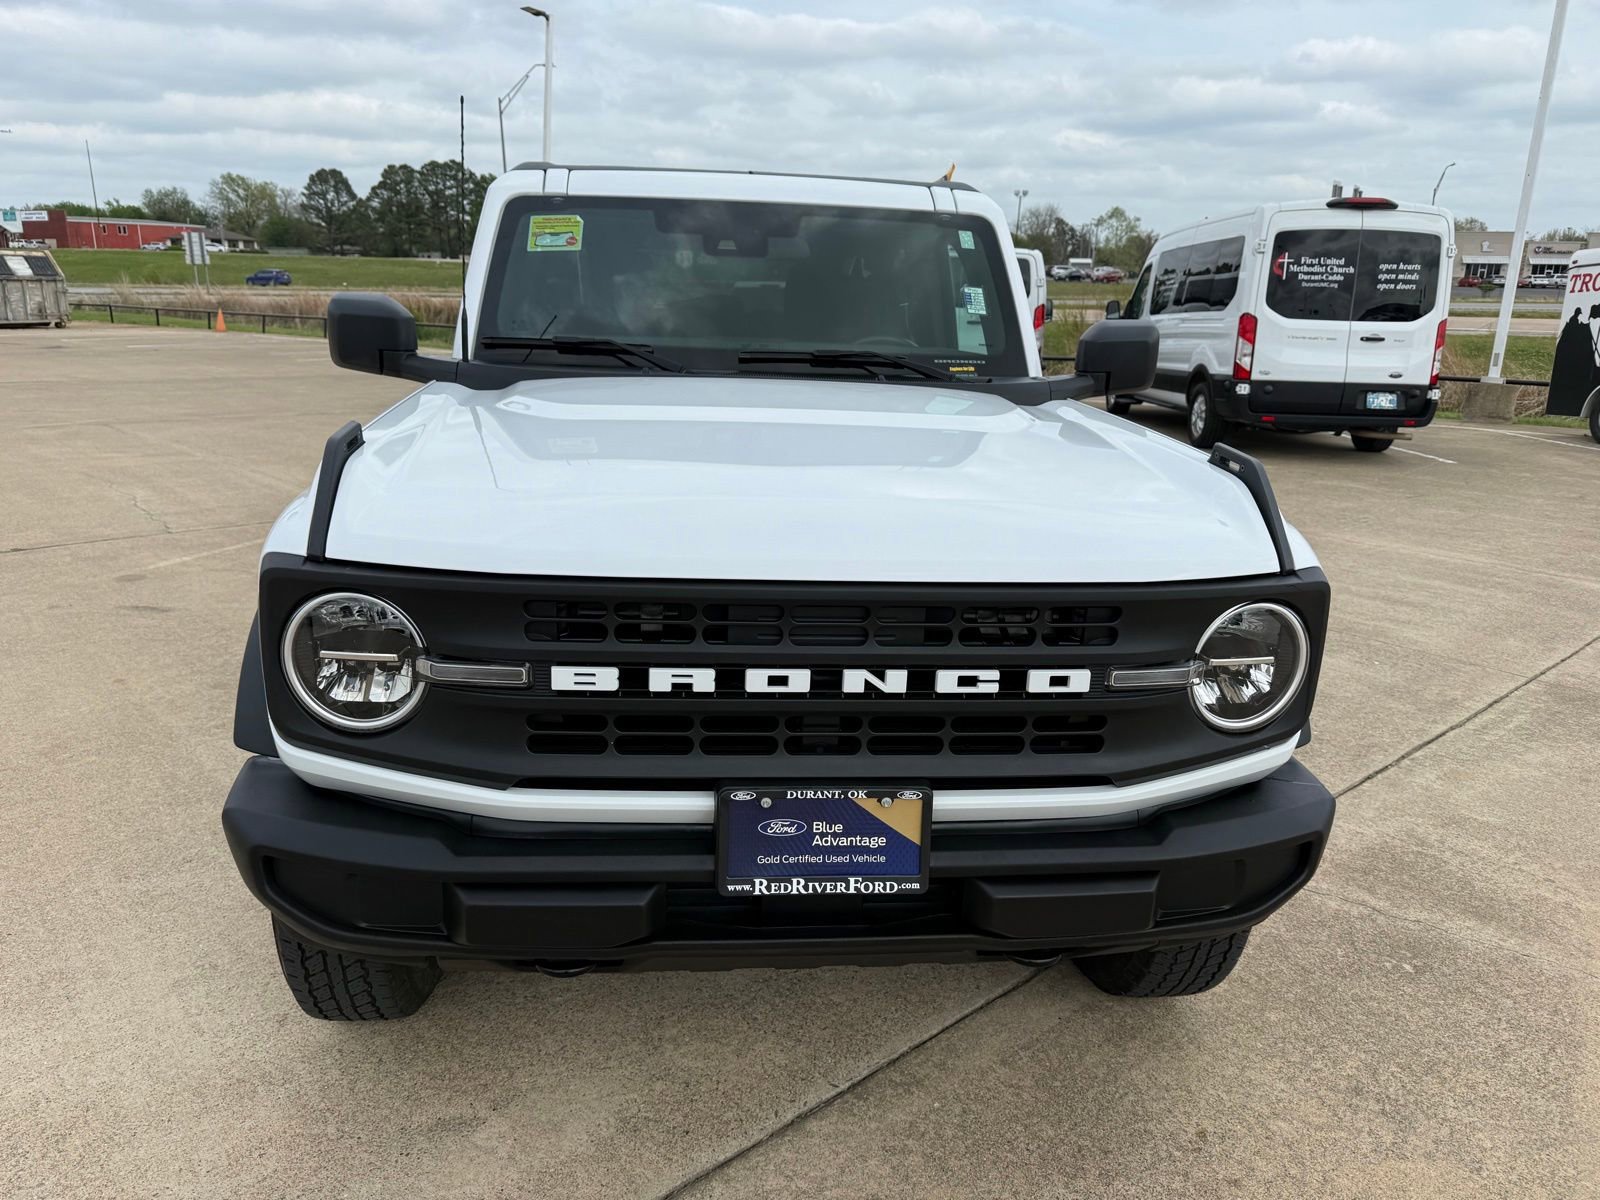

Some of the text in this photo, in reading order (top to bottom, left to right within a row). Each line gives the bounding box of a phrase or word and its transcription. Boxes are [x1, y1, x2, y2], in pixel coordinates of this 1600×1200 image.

[1301, 256, 1345, 265] First United
[1288, 264, 1355, 274] Methodist Church
[1379, 262, 1421, 271] open hearts
[1298, 273, 1345, 281] Durant-Caddo
[1377, 272, 1420, 281] open minds
[1376, 282, 1417, 291] open doors
[551, 665, 1092, 694] BRONCO
[786, 790, 868, 800] DURANT, OK
[767, 821, 798, 834] Ford
[813, 821, 844, 833] Blue
[811, 834, 887, 849] Advantage
[757, 854, 886, 864] Gold Certified Used Vehicle
